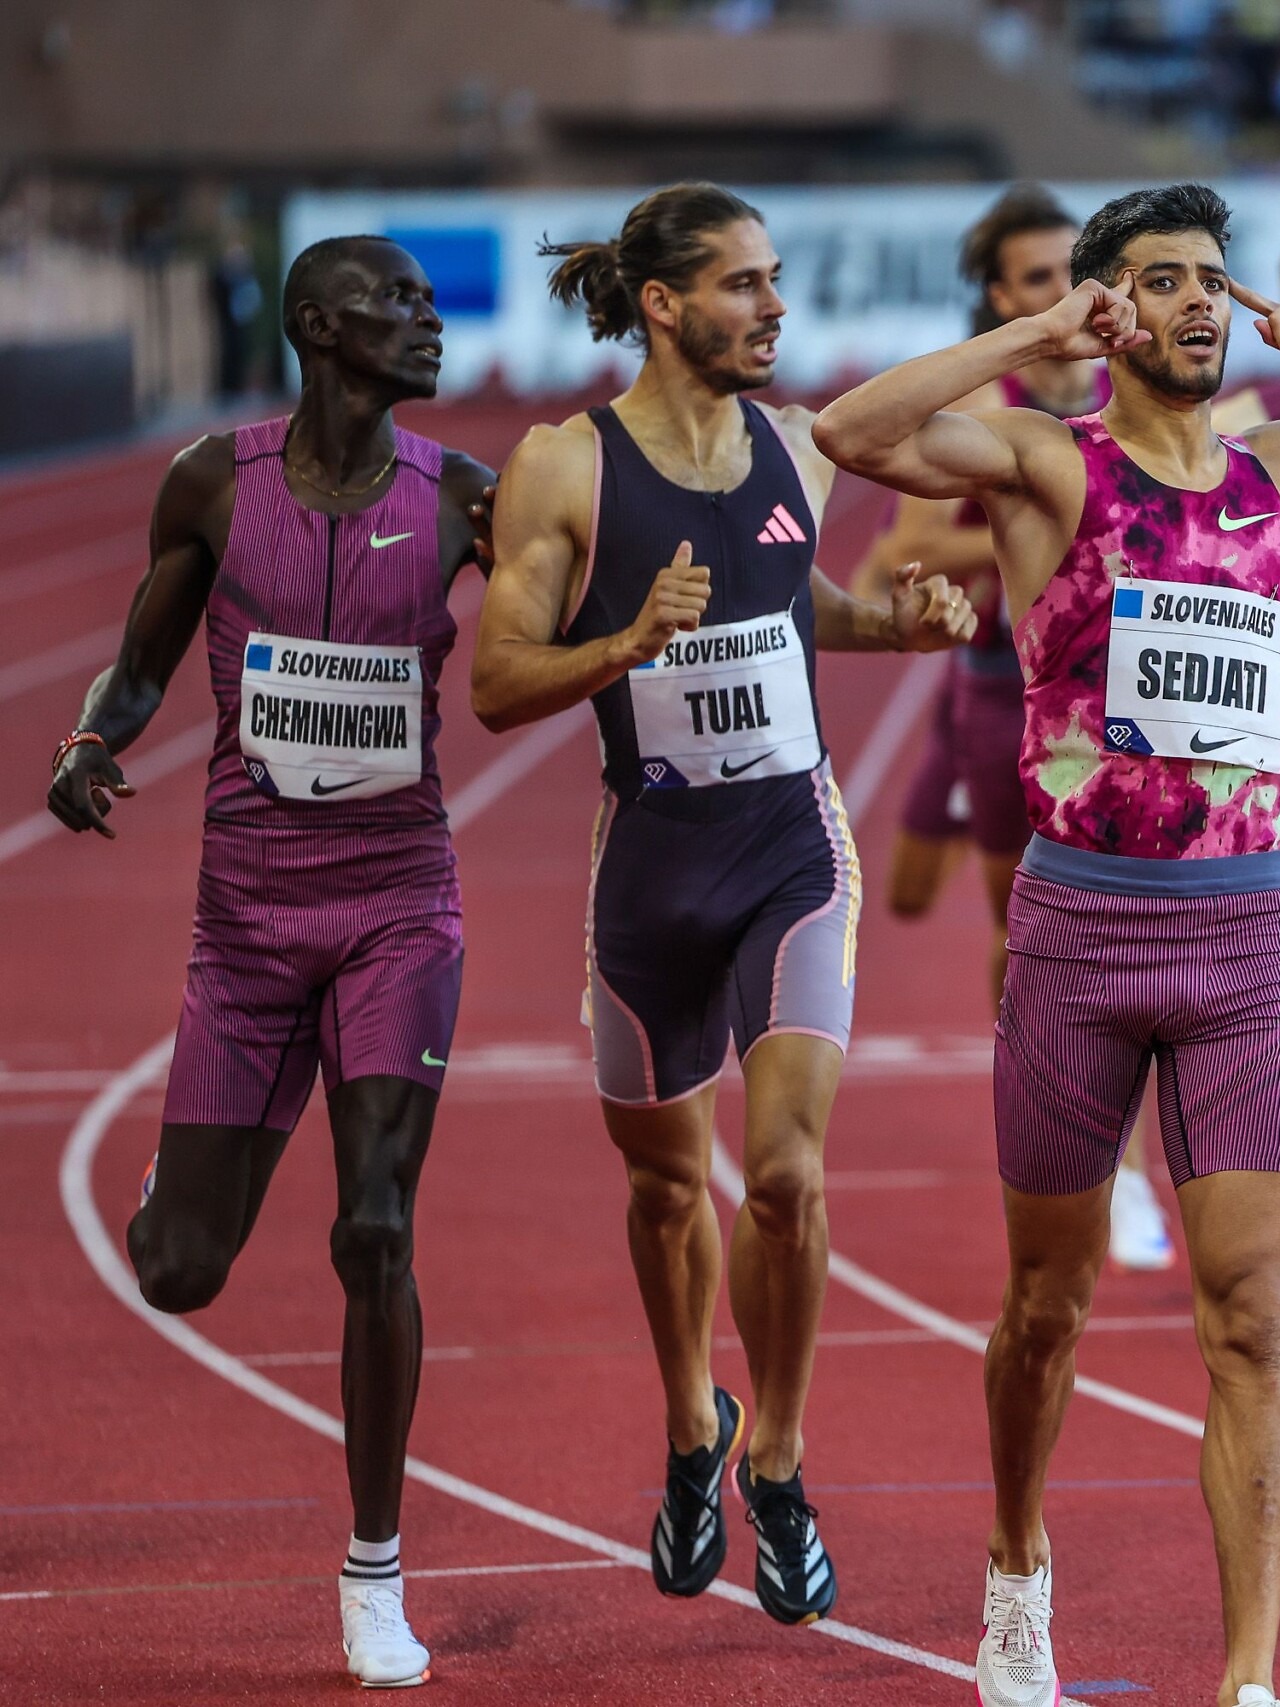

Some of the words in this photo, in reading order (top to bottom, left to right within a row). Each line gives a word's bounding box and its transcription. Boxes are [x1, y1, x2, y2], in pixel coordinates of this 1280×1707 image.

[1150, 593, 1276, 639] SLOVENIJALES
[278, 649, 411, 683] SLOVENIJALES
[664, 625, 788, 667] SLOVENIJALES
[1136, 648, 1267, 714] SEDJATI
[250, 692, 408, 749] CHEMININGWA
[683, 682, 771, 736] TUAL
